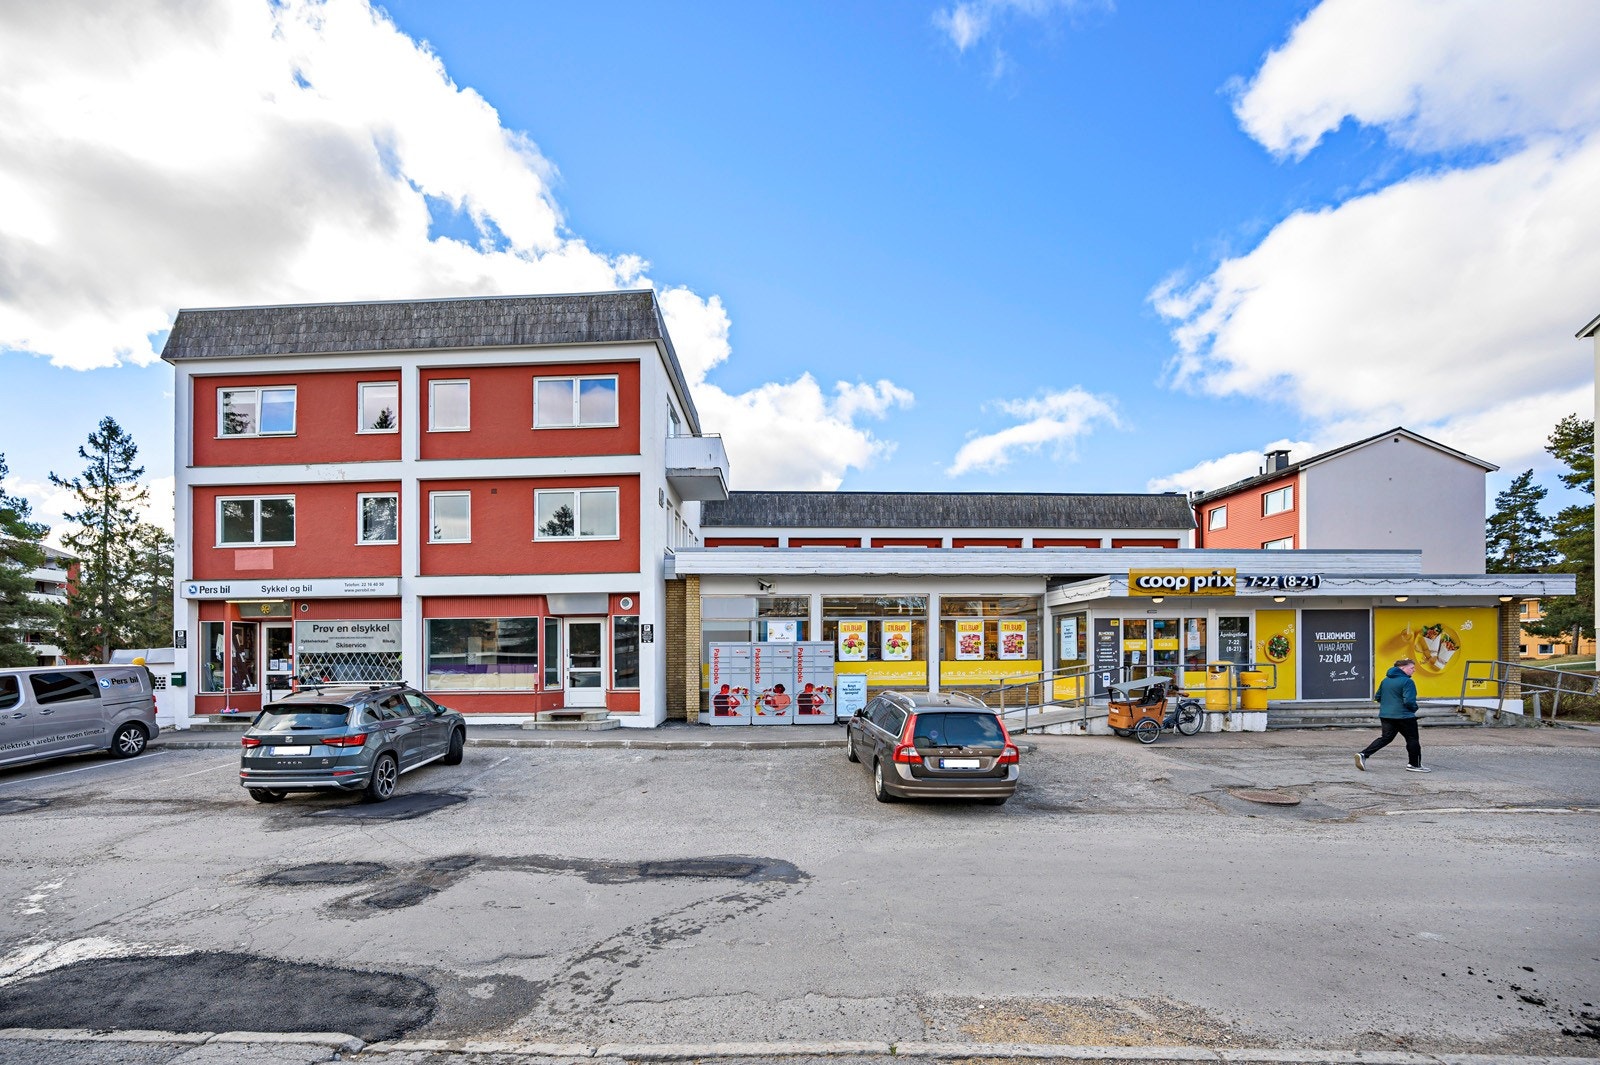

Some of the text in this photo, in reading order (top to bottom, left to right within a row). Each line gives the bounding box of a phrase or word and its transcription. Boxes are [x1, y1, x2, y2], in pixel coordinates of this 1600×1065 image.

[1138, 570, 1235, 593] coop prix
[1249, 574, 1322, 589] 7-22 (8-21)
[199, 585, 231, 594] Pers bil
[261, 584, 313, 594] Sykkel og bil
[313, 623, 390, 634] Prøv en elsykkel
[1315, 632, 1356, 640] VELKOMMEN!
[1317, 641, 1354, 651] VI HAR ÅPENT
[1319, 653, 1352, 663] 7-22 (8-21)
[129, 676, 139, 684] bil
[0, 740, 32, 751] elektrisk
[67, 731, 83, 739] noen
